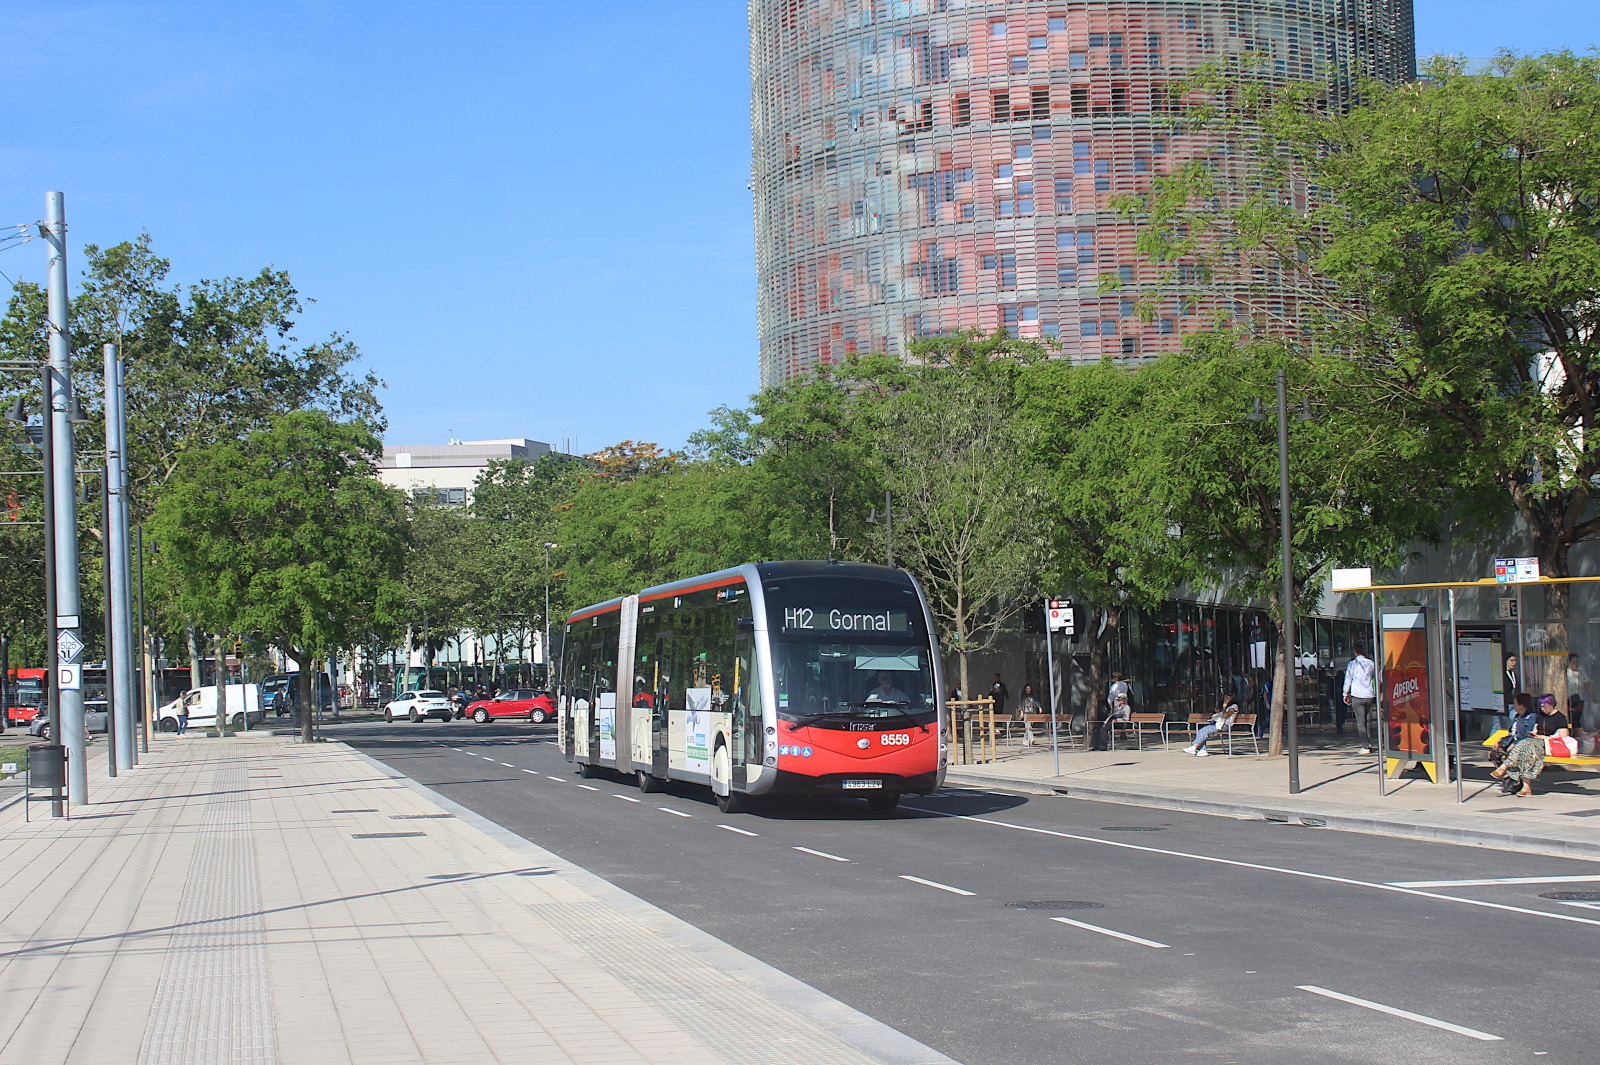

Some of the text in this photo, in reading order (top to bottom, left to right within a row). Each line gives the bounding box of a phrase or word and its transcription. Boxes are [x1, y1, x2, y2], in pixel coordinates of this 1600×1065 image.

[784, 607, 891, 631] H12 Gornal
[66, 641, 77, 650] 25
[61, 669, 73, 684] D
[1392, 677, 1420, 699] APEROL
[880, 733, 910, 746] 8559
